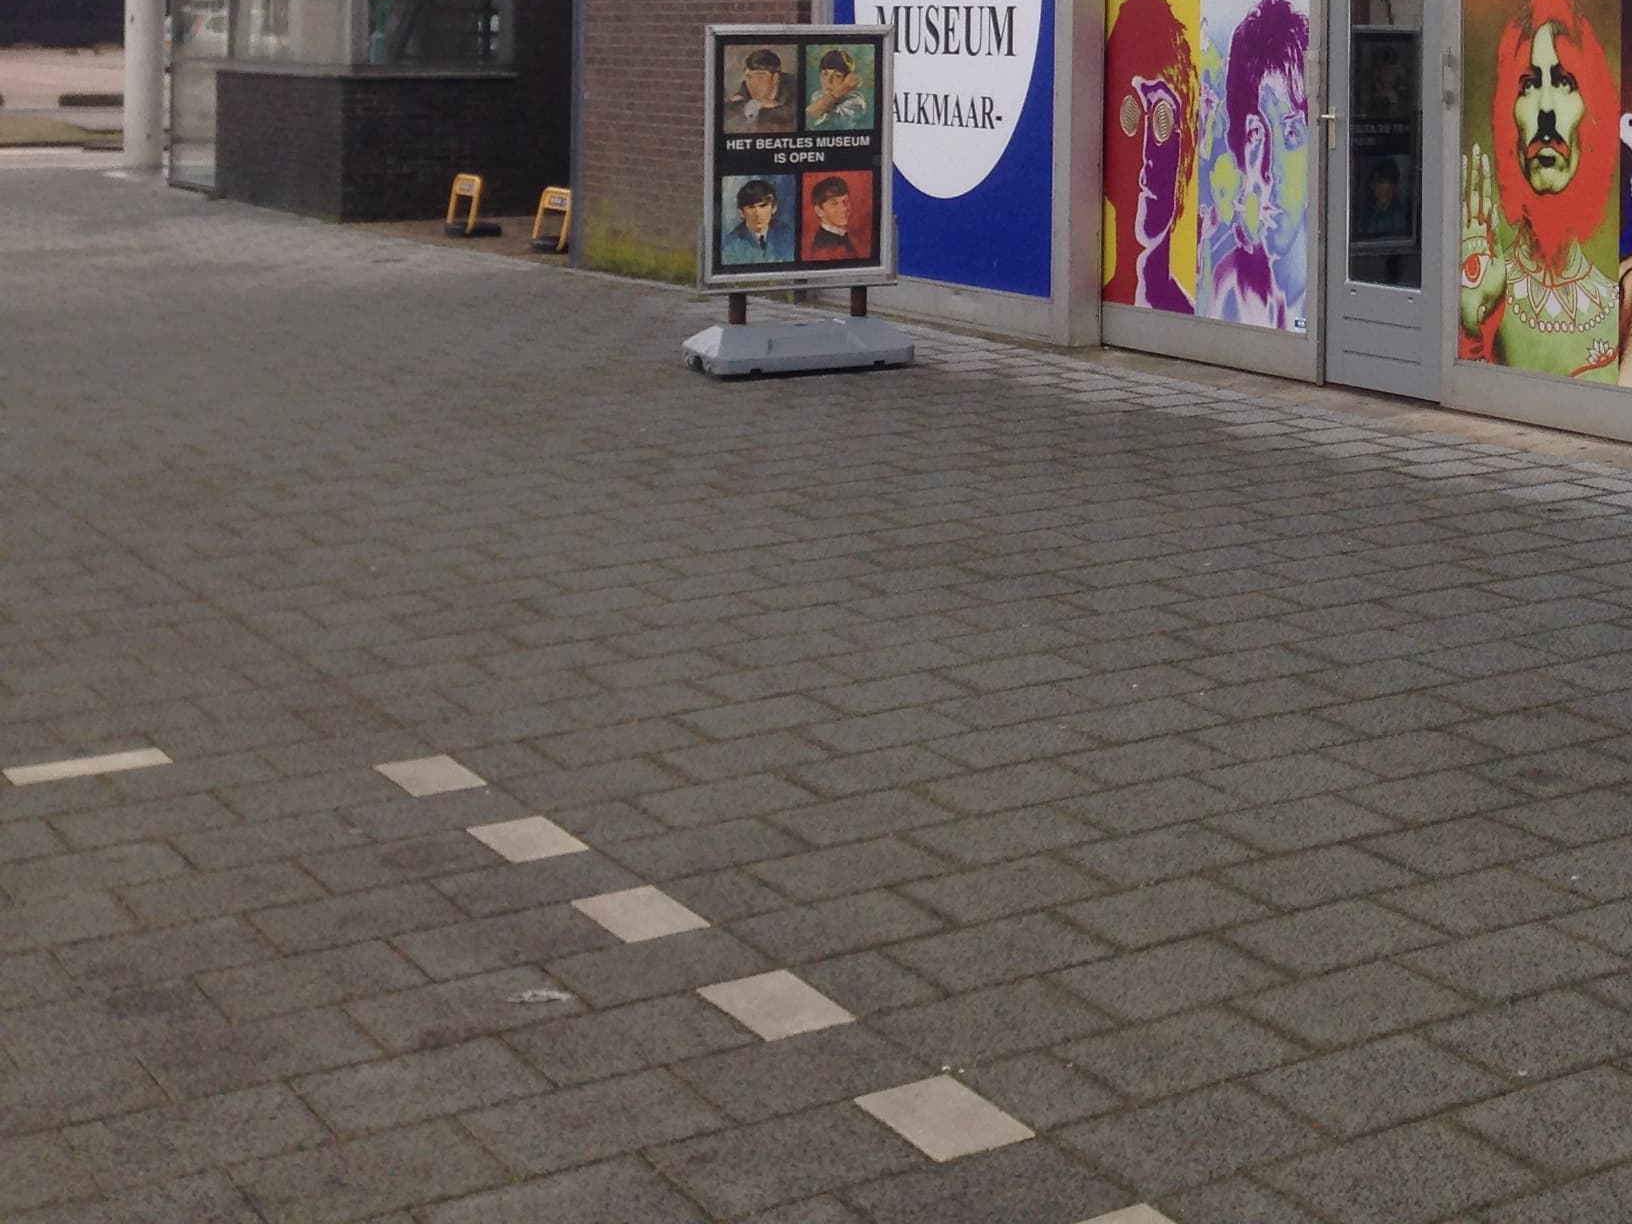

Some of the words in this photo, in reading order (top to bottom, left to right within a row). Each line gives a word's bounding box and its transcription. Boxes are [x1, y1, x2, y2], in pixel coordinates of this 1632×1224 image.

[875, 4, 1017, 57] MUSEUM
[726, 138, 752, 151] HET
[755, 137, 814, 150] BEATLES
[816, 135, 871, 148] MUSEUM
[774, 153, 787, 164] IS
[789, 151, 825, 164] OPEN
